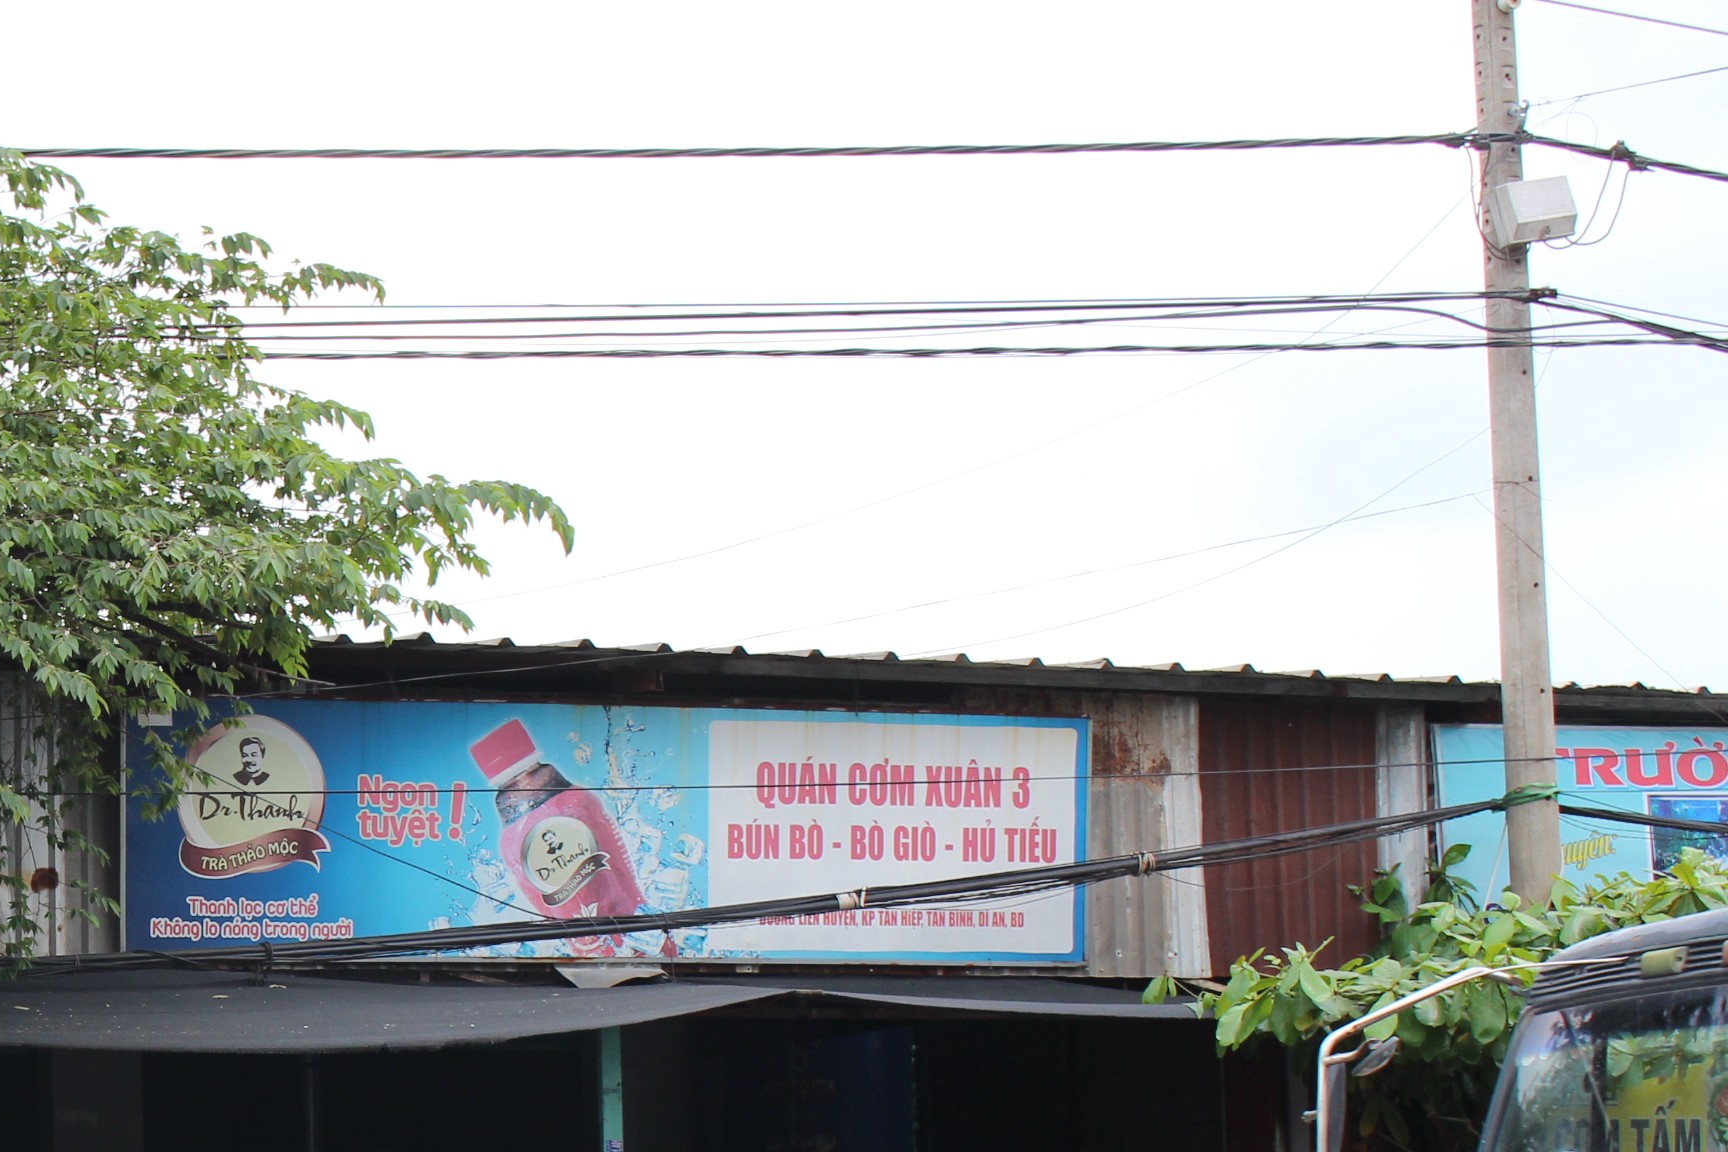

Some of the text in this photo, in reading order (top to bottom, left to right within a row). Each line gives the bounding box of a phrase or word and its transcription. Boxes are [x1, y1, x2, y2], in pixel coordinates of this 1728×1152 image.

[358, 774, 437, 813] Ngon
[756, 756, 1030, 809] QUÁN CƠM XUÂN 3
[357, 809, 441, 846] tuyệt
[727, 818, 780, 860] BÚN
[789, 819, 823, 860] BÒ
[850, 819, 884, 861] BÒ
[893, 820, 936, 861] GIÒ
[962, 818, 996, 862] HỦ
[1004, 816, 1057, 863] TIẾU
[201, 838, 298, 871] TRÀ THẢO MỘC
[187, 894, 318, 919] Thanh lọc cơ thể
[862, 911, 874, 926] KP
[151, 917, 353, 940] Không lo nóng trong người
